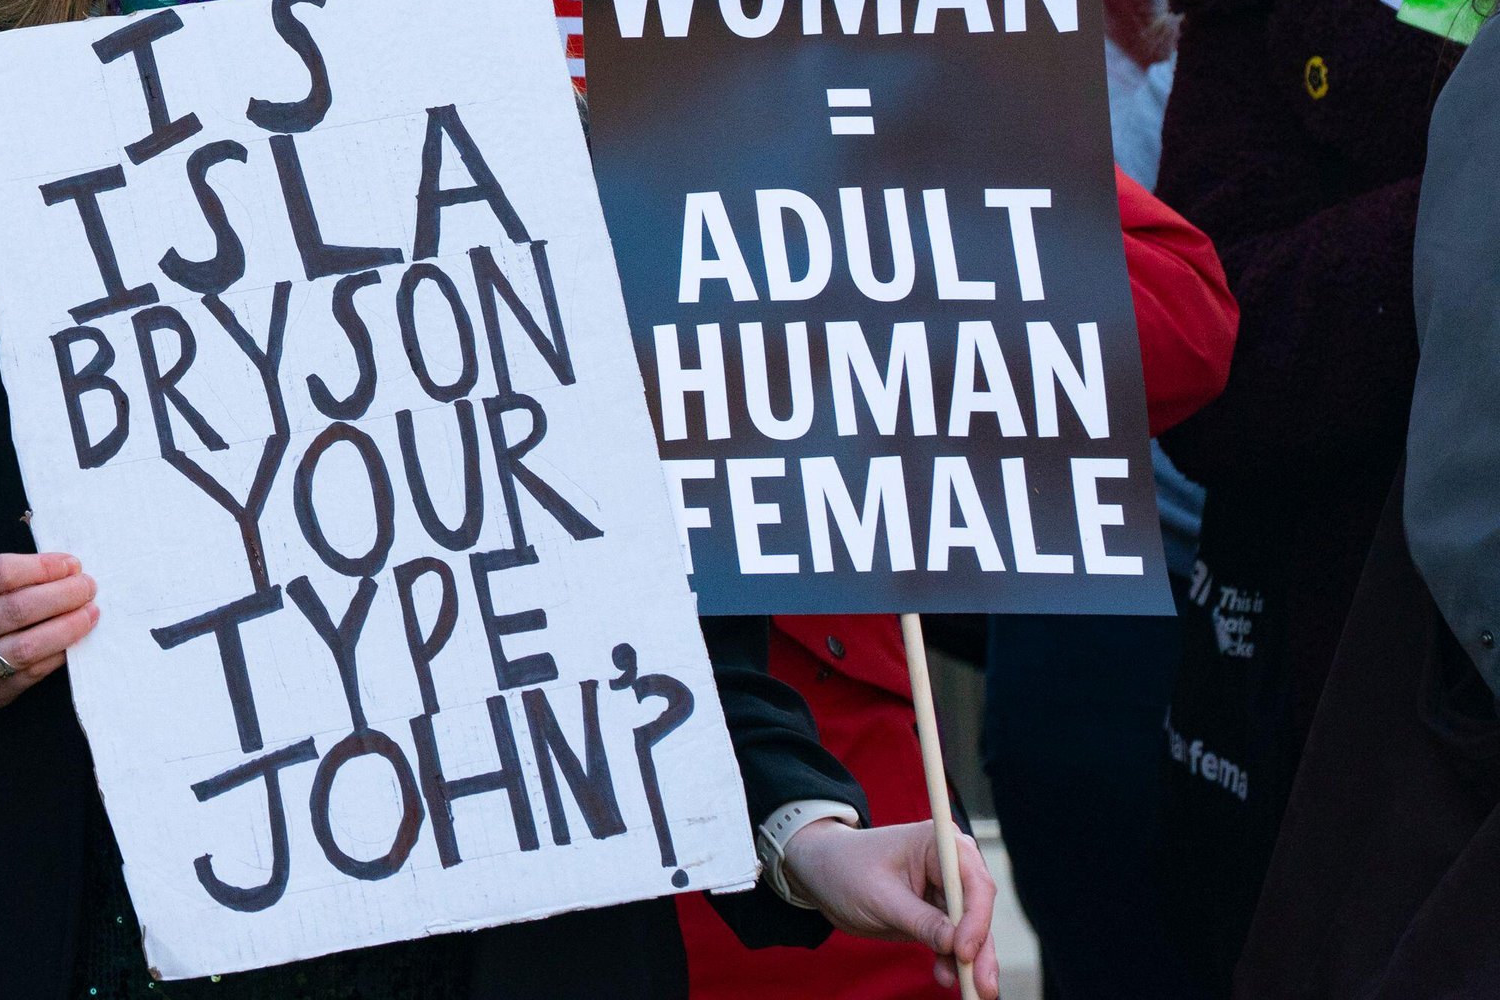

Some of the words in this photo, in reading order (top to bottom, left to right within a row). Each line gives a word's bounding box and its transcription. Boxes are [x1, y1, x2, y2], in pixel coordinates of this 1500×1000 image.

[38, 104, 532, 324] ISLA
[677, 186, 1052, 304] ADULT
[50, 239, 577, 470] BRYSON
[653, 319, 1112, 442] HUMAN
[162, 396, 604, 596] YOUR
[661, 455, 1145, 577] FEMALE
[150, 545, 560, 753] TYPE
